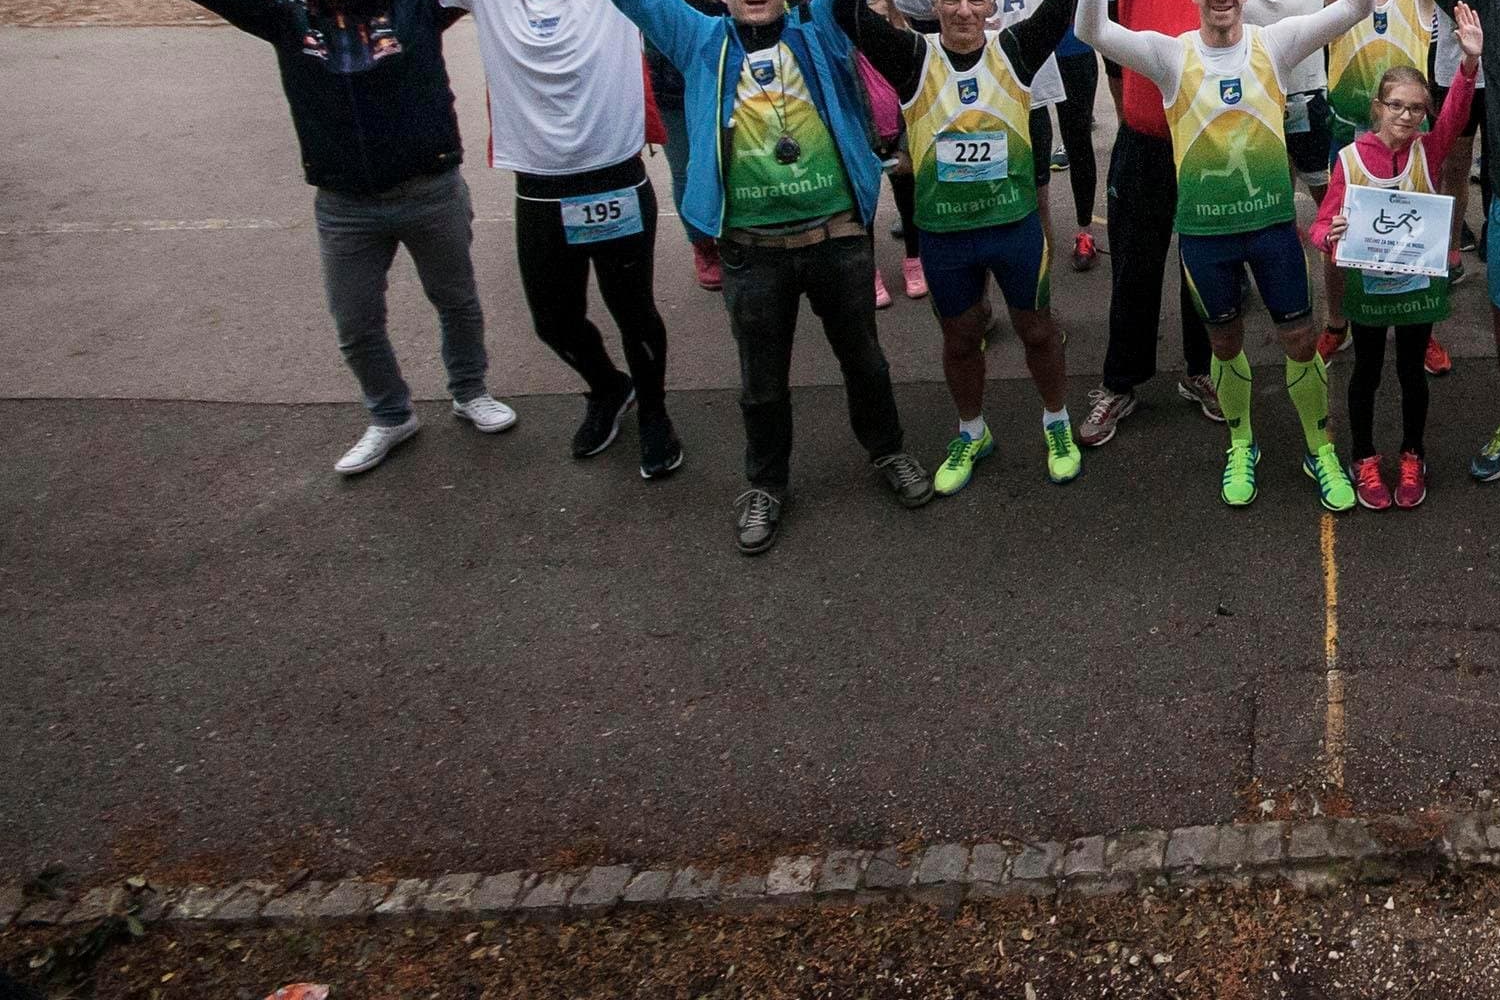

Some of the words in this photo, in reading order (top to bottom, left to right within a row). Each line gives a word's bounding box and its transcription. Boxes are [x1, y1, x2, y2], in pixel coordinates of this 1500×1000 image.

[955, 142, 991, 163] 222
[735, 173, 834, 199] maraton.hr
[582, 200, 621, 224] 195
[1196, 192, 1282, 216] maraton.hr
[1361, 296, 1440, 315] maraton.hr
